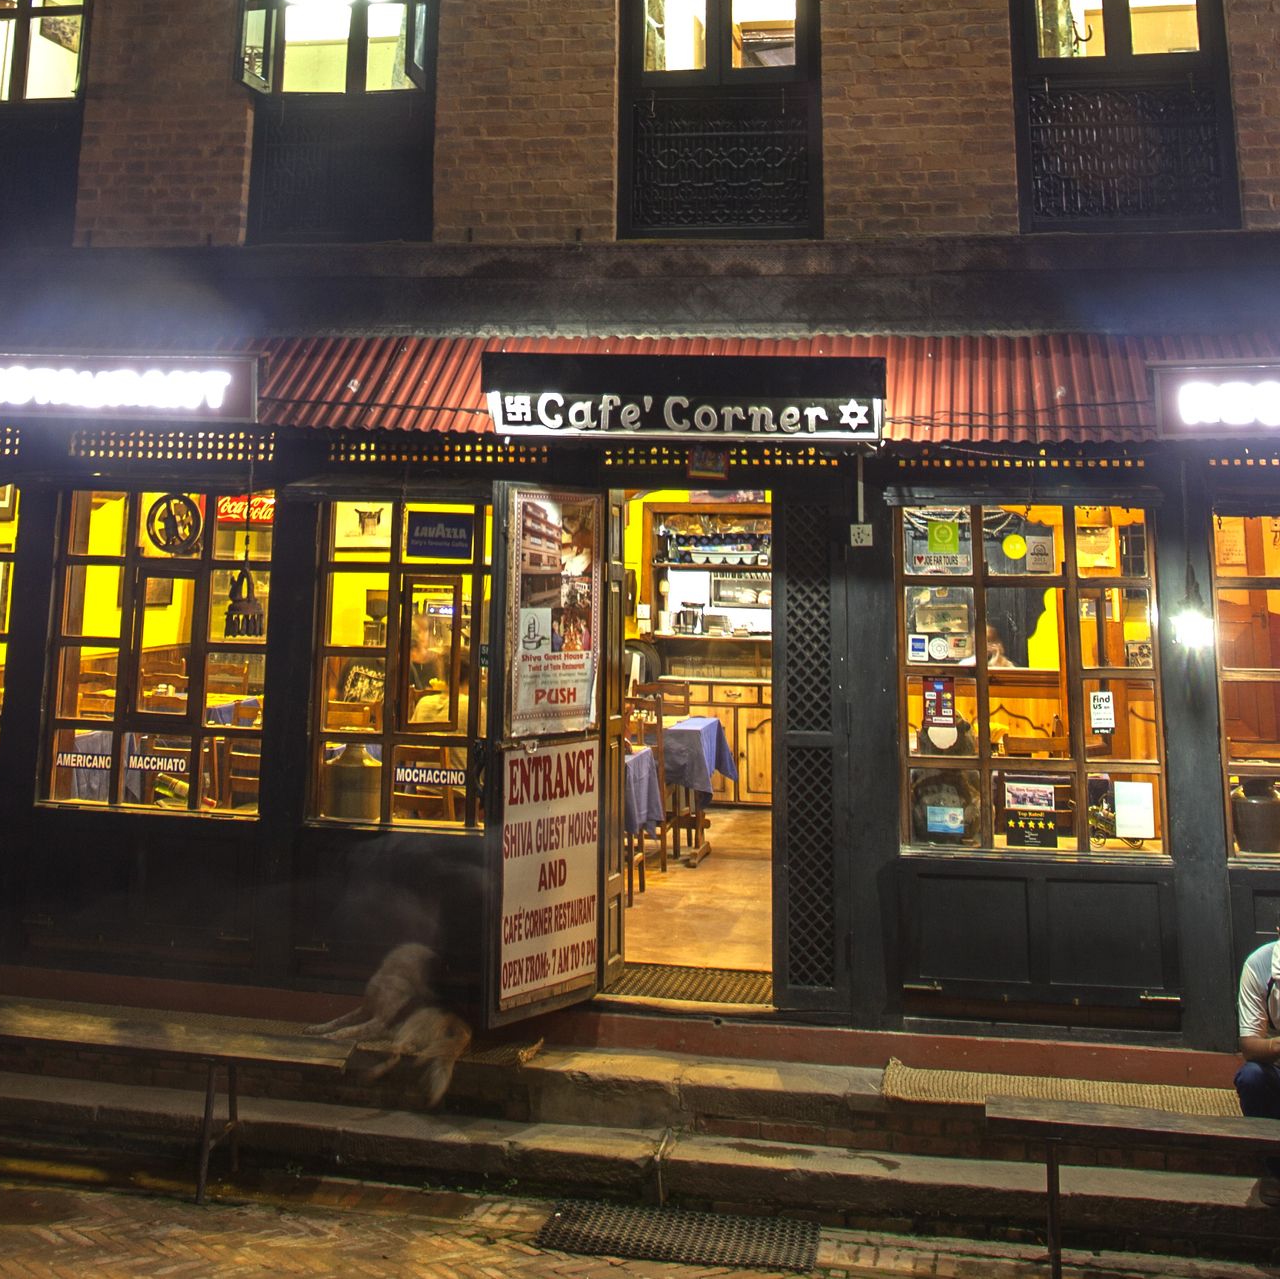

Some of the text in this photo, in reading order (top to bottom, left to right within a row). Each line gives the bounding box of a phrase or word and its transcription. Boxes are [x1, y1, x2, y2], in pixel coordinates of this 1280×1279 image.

[537, 392, 829, 434] Cafe' Corner
[414, 523, 467, 539] LAVAZZA
[522, 654, 542, 662] Shiva
[564, 652, 583, 660] House
[534, 687, 577, 705] PUSH
[56, 753, 111, 769] AMERICANO
[129, 755, 186, 771] MACCHIATO
[396, 768, 465, 784] MOCHACCINO
[508, 749, 595, 806] ENTRANCE
[504, 810, 597, 860] SHIVA GUEST HOUSE
[538, 859, 567, 892] AND
[524, 906, 553, 940] CORNER
[554, 895, 596, 932] RESTAURANT
[502, 958, 524, 990] OPEN
[552, 948, 557, 976] 7
[557, 945, 569, 974] AM
[570, 942, 580, 970] TO
[581, 940, 586, 966] 9
[586, 938, 596, 966] PM
